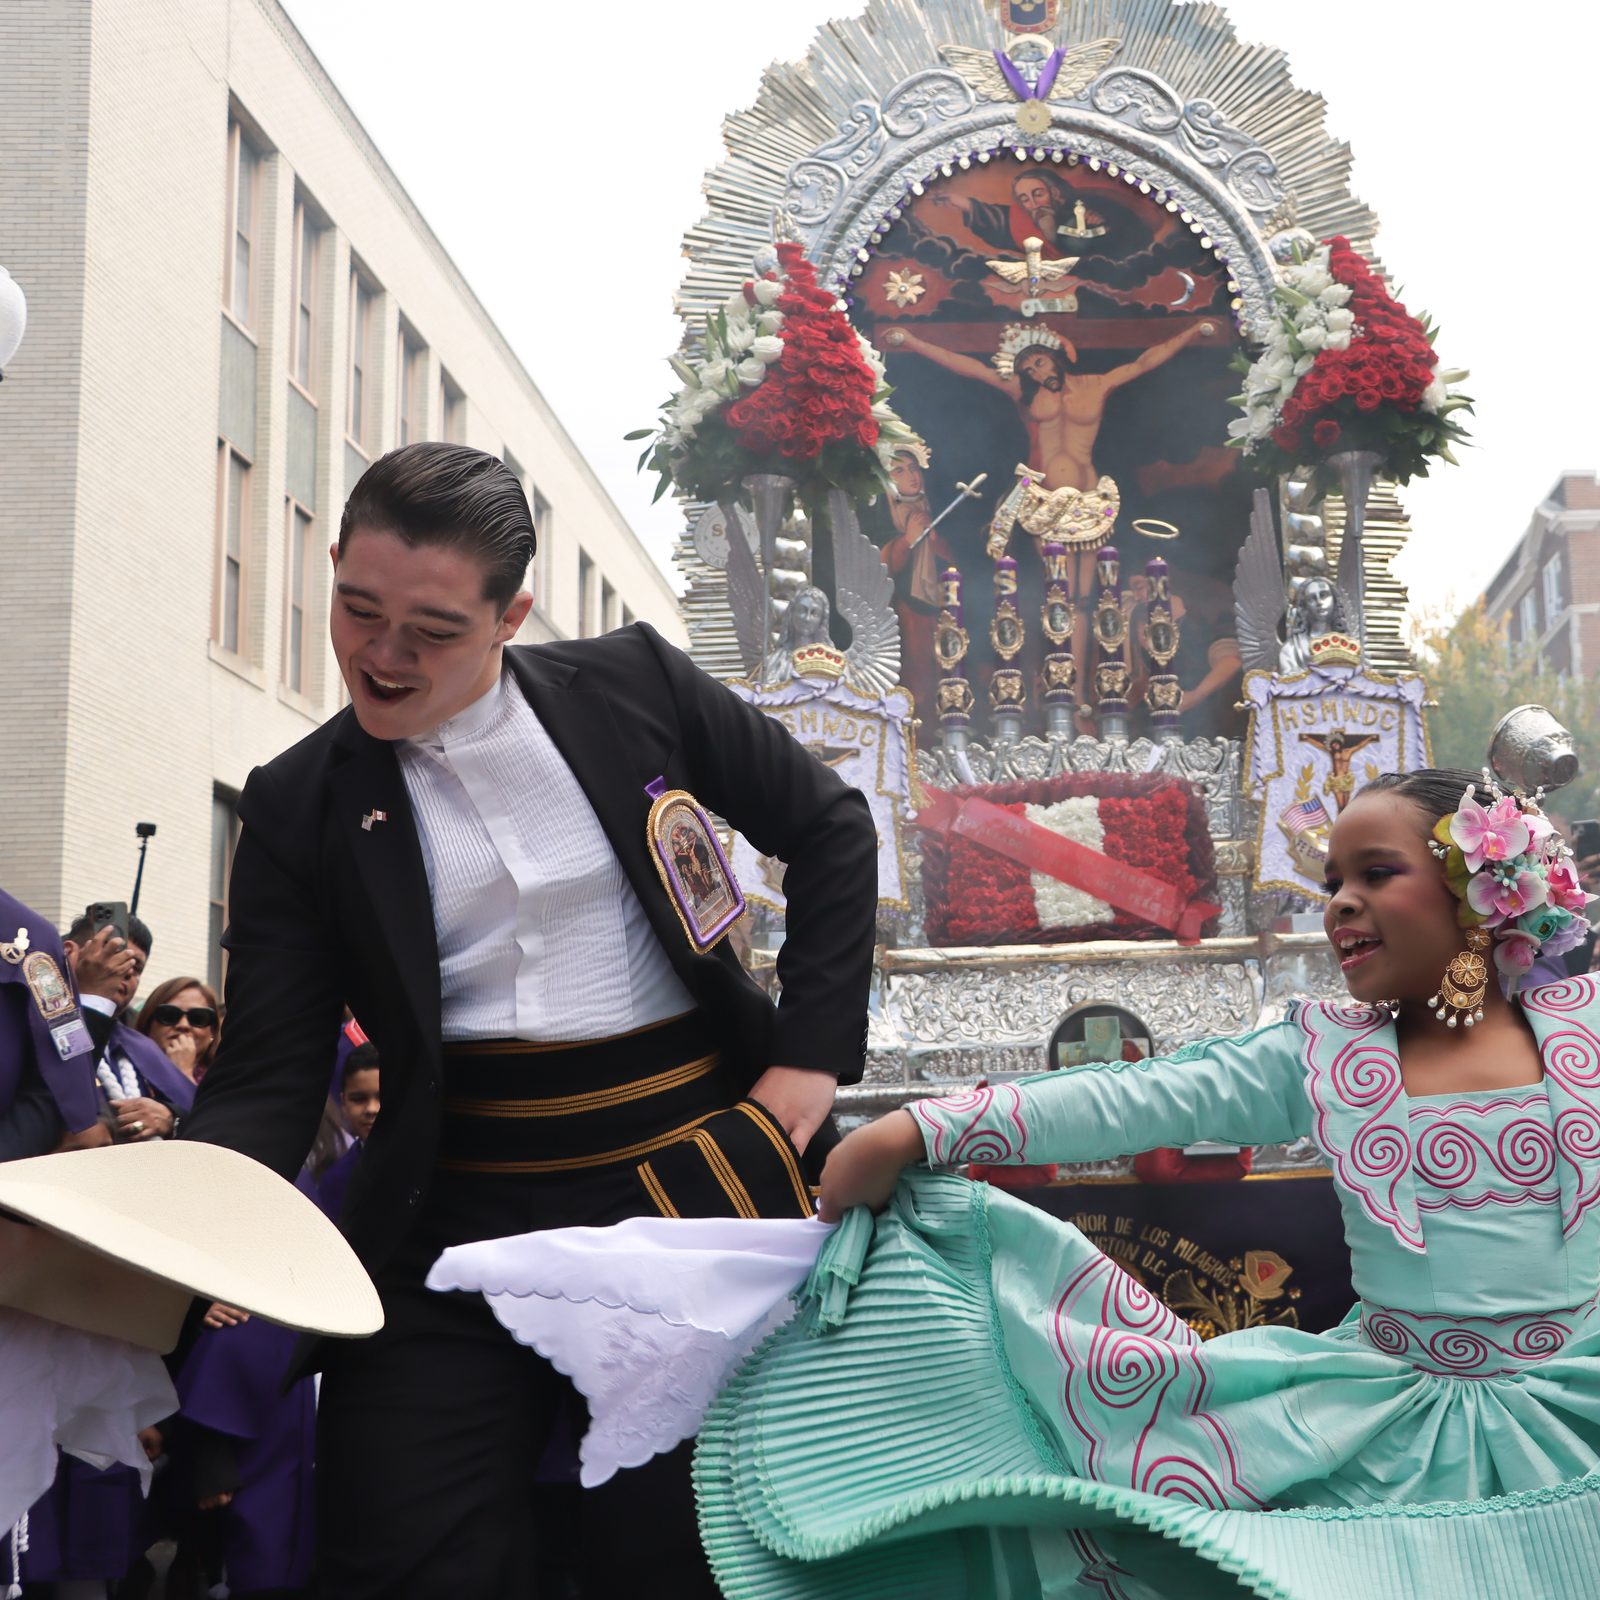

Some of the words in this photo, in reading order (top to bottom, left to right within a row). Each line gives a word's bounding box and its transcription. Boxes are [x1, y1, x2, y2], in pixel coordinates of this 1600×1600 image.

[993, 570, 1018, 595] S
[779, 709, 877, 747] SMWDC
[1280, 698, 1396, 732] HSMWDC
[1069, 1211, 1107, 1233] ÑOR
[1114, 1215, 1135, 1235] DE
[1140, 1224, 1171, 1248] LOS
[1173, 1237, 1236, 1287] MILAGROS
